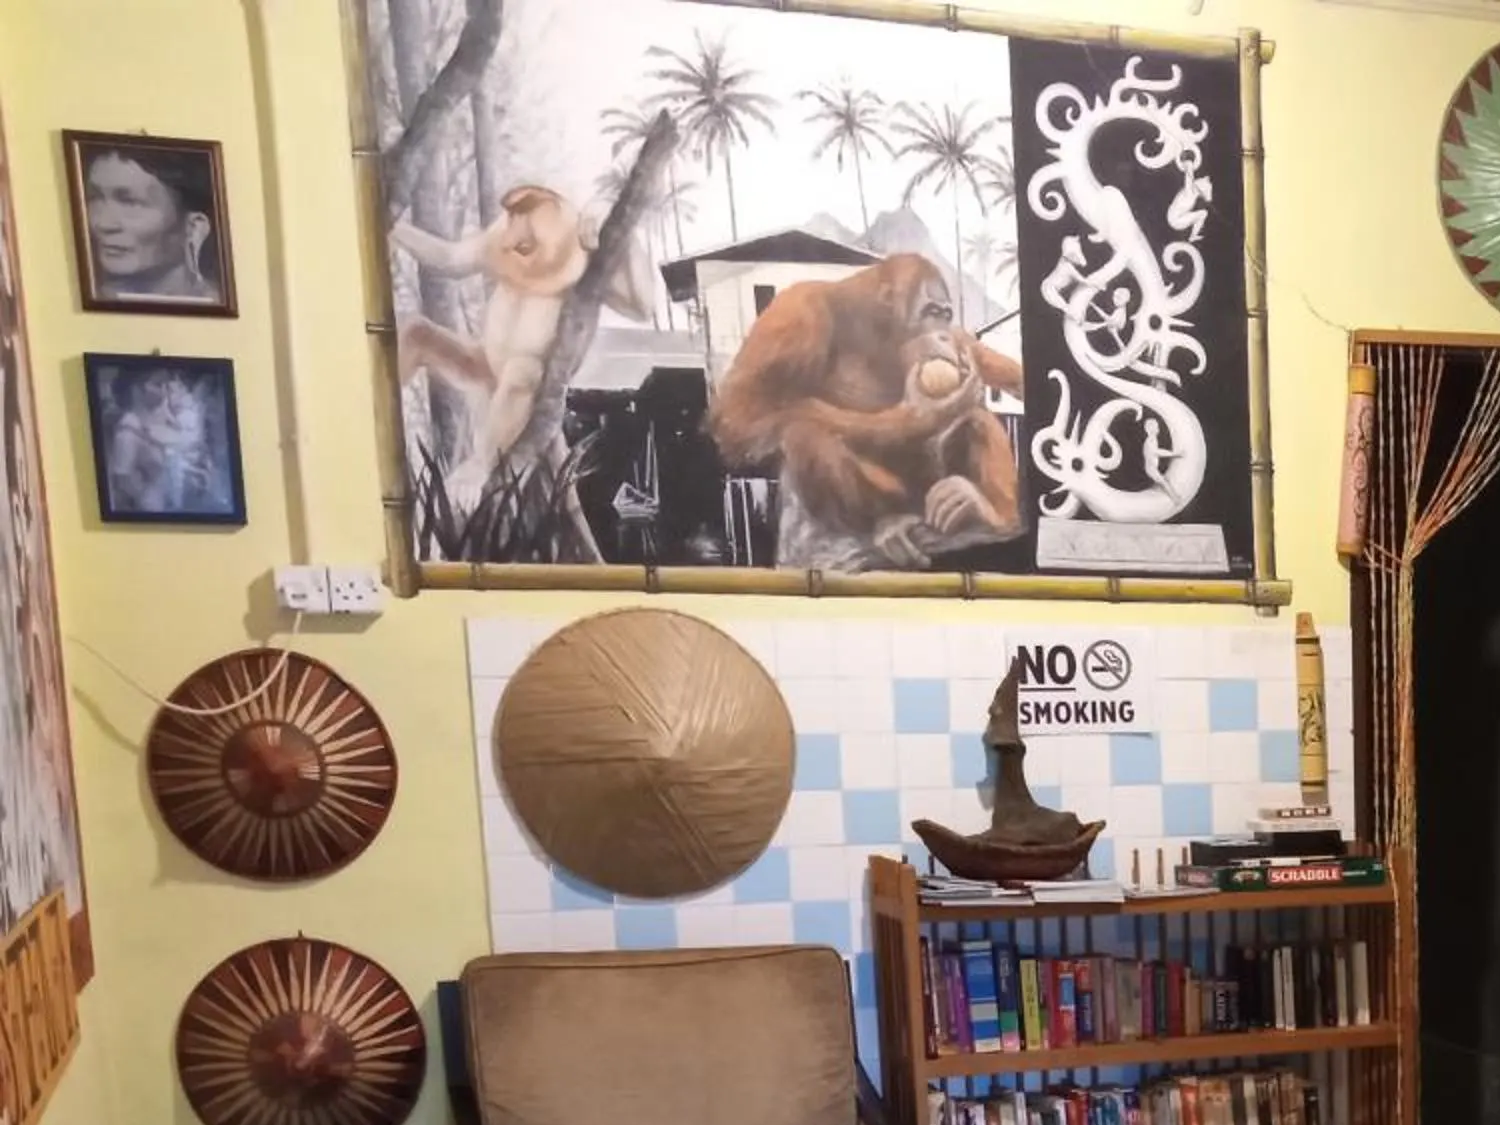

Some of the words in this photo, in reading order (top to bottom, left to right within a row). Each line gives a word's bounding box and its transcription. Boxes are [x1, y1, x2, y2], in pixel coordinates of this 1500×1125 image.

[1018, 645, 1077, 685] NO
[1019, 700, 1135, 724] SMOKING
[1271, 868, 1341, 883] SCRABBLE
